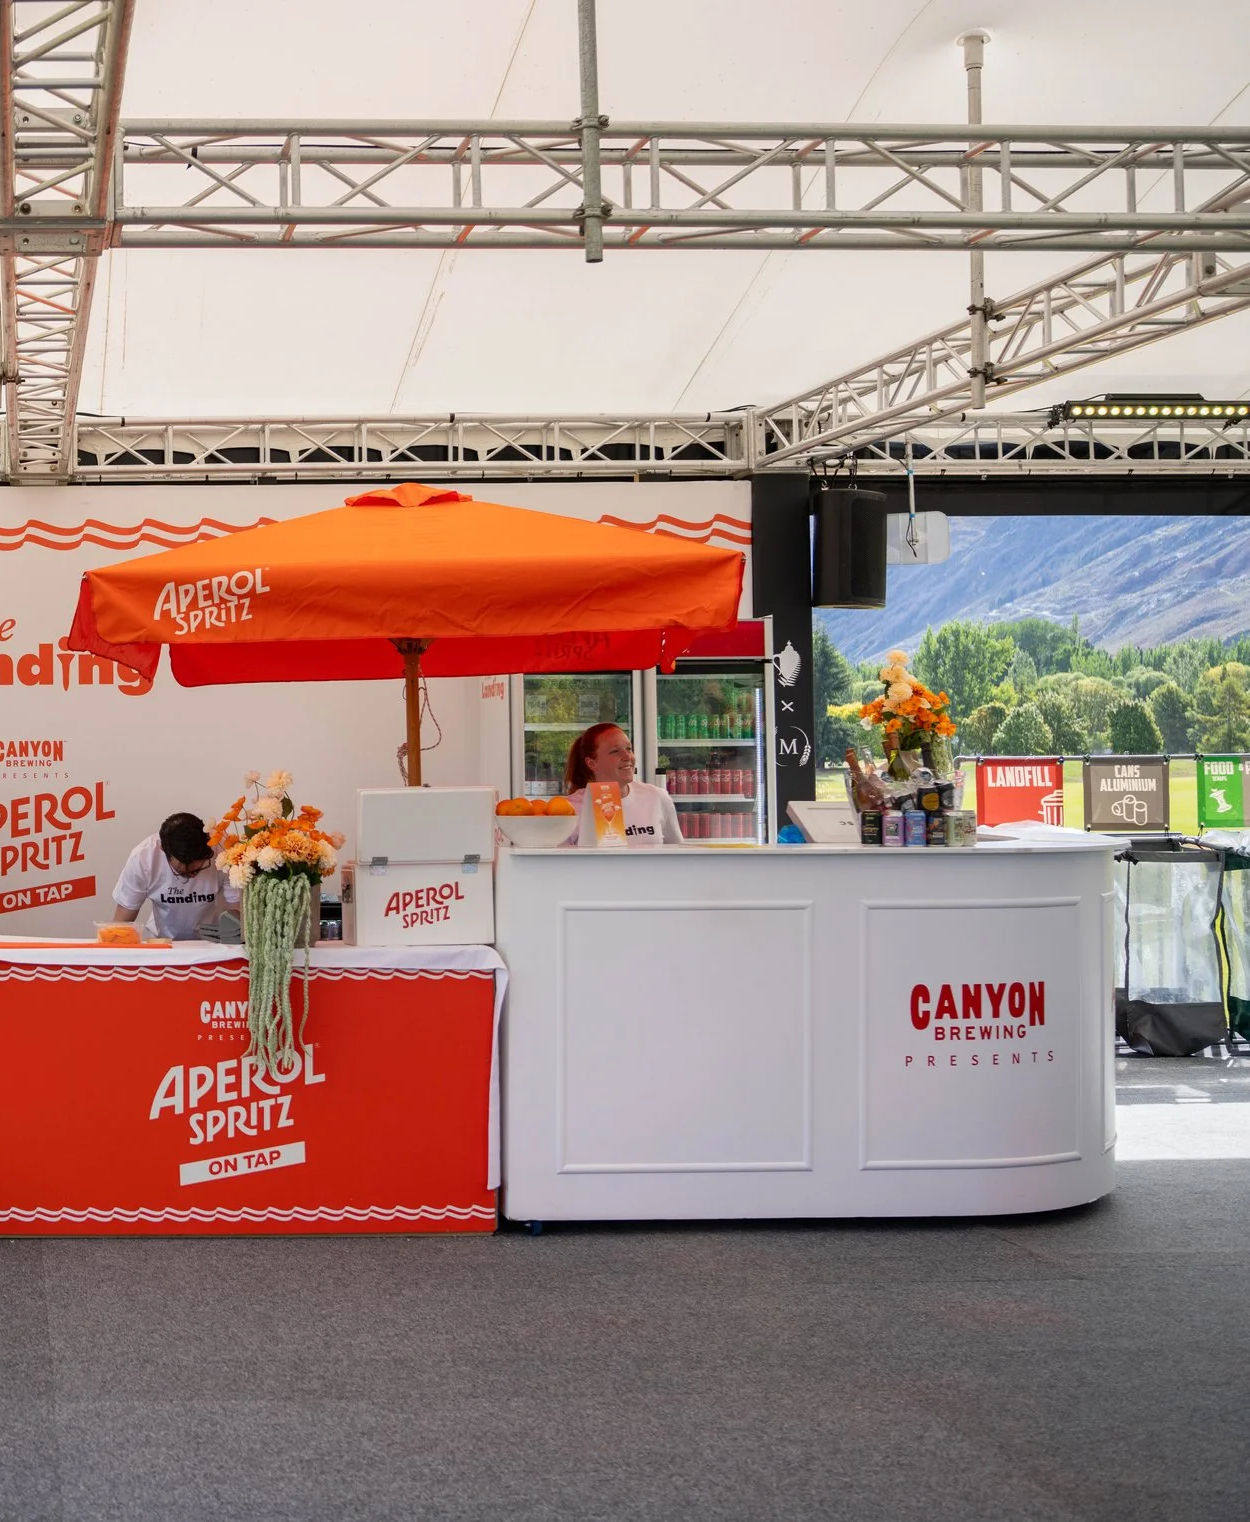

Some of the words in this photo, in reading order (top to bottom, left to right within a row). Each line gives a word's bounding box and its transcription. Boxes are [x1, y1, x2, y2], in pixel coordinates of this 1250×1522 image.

[153, 568, 270, 620] APEROL
[778, 738, 798, 755] M
[986, 766, 1053, 788] LANDFILL
[1114, 764, 1141, 778] CANS
[1204, 761, 1234, 775] FOOD
[1100, 778, 1157, 792] ALUMINIUM
[625, 824, 655, 836] ding
[2, 891, 31, 909] ON
[35, 883, 73, 903] TAP
[160, 892, 215, 904] Landing
[167, 886, 185, 895] The
[384, 881, 465, 917] APEROL
[402, 905, 451, 929] SPRITZ
[200, 1001, 249, 1024] CANY
[910, 981, 1045, 1030] CANYON
[211, 1021, 249, 1029] BREWI
[934, 1024, 1027, 1041] BREWING
[905, 1050, 1054, 1067] PRESENTS
[149, 1043, 326, 1120] APEROL
[189, 1095, 295, 1146] SPRITZ
[208, 1157, 238, 1175] ON
[243, 1150, 281, 1170] TAP
